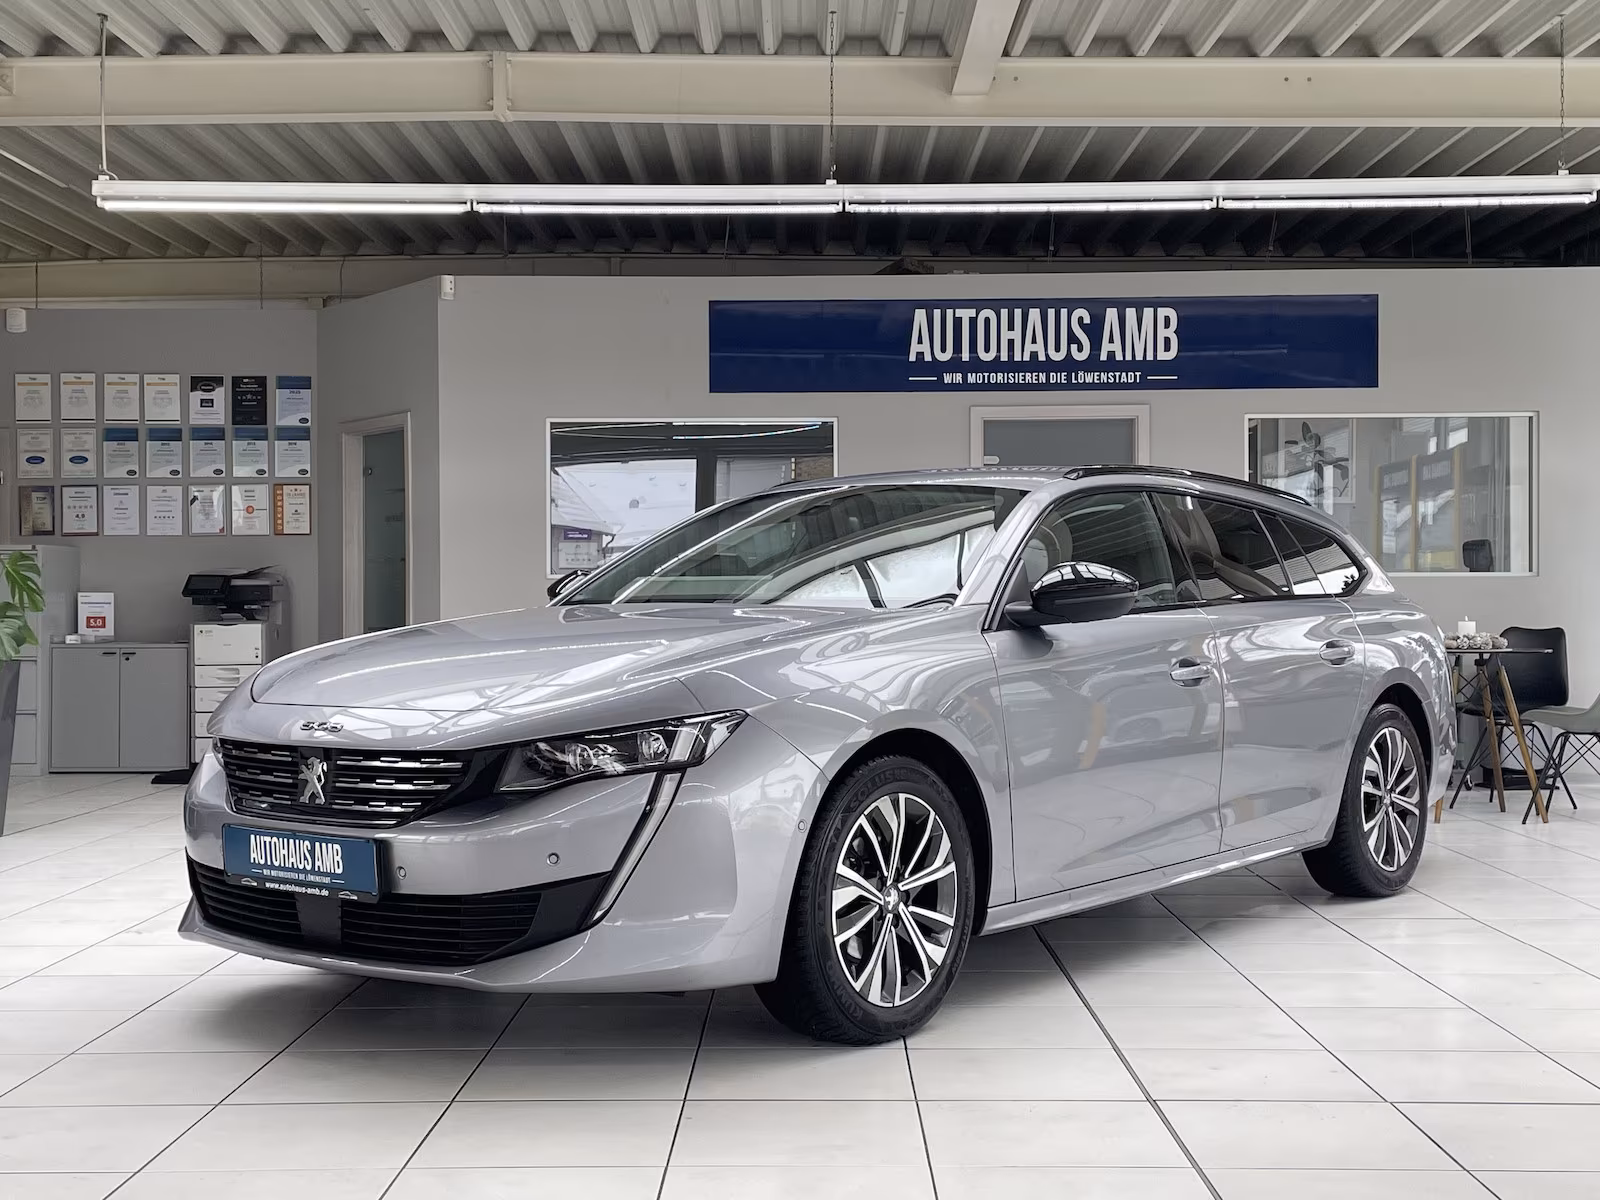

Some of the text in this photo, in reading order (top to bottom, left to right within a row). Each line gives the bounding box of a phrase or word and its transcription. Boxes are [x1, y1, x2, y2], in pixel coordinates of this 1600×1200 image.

[908, 306, 1179, 363] AUTOHAUS AMB
[943, 370, 1142, 384] WIR MOTORISIEREN DIE LÖWENSTADT
[250, 834, 343, 874] AUTOHAUS AMB
[265, 881, 329, 896] www.autohaus-amb.de
